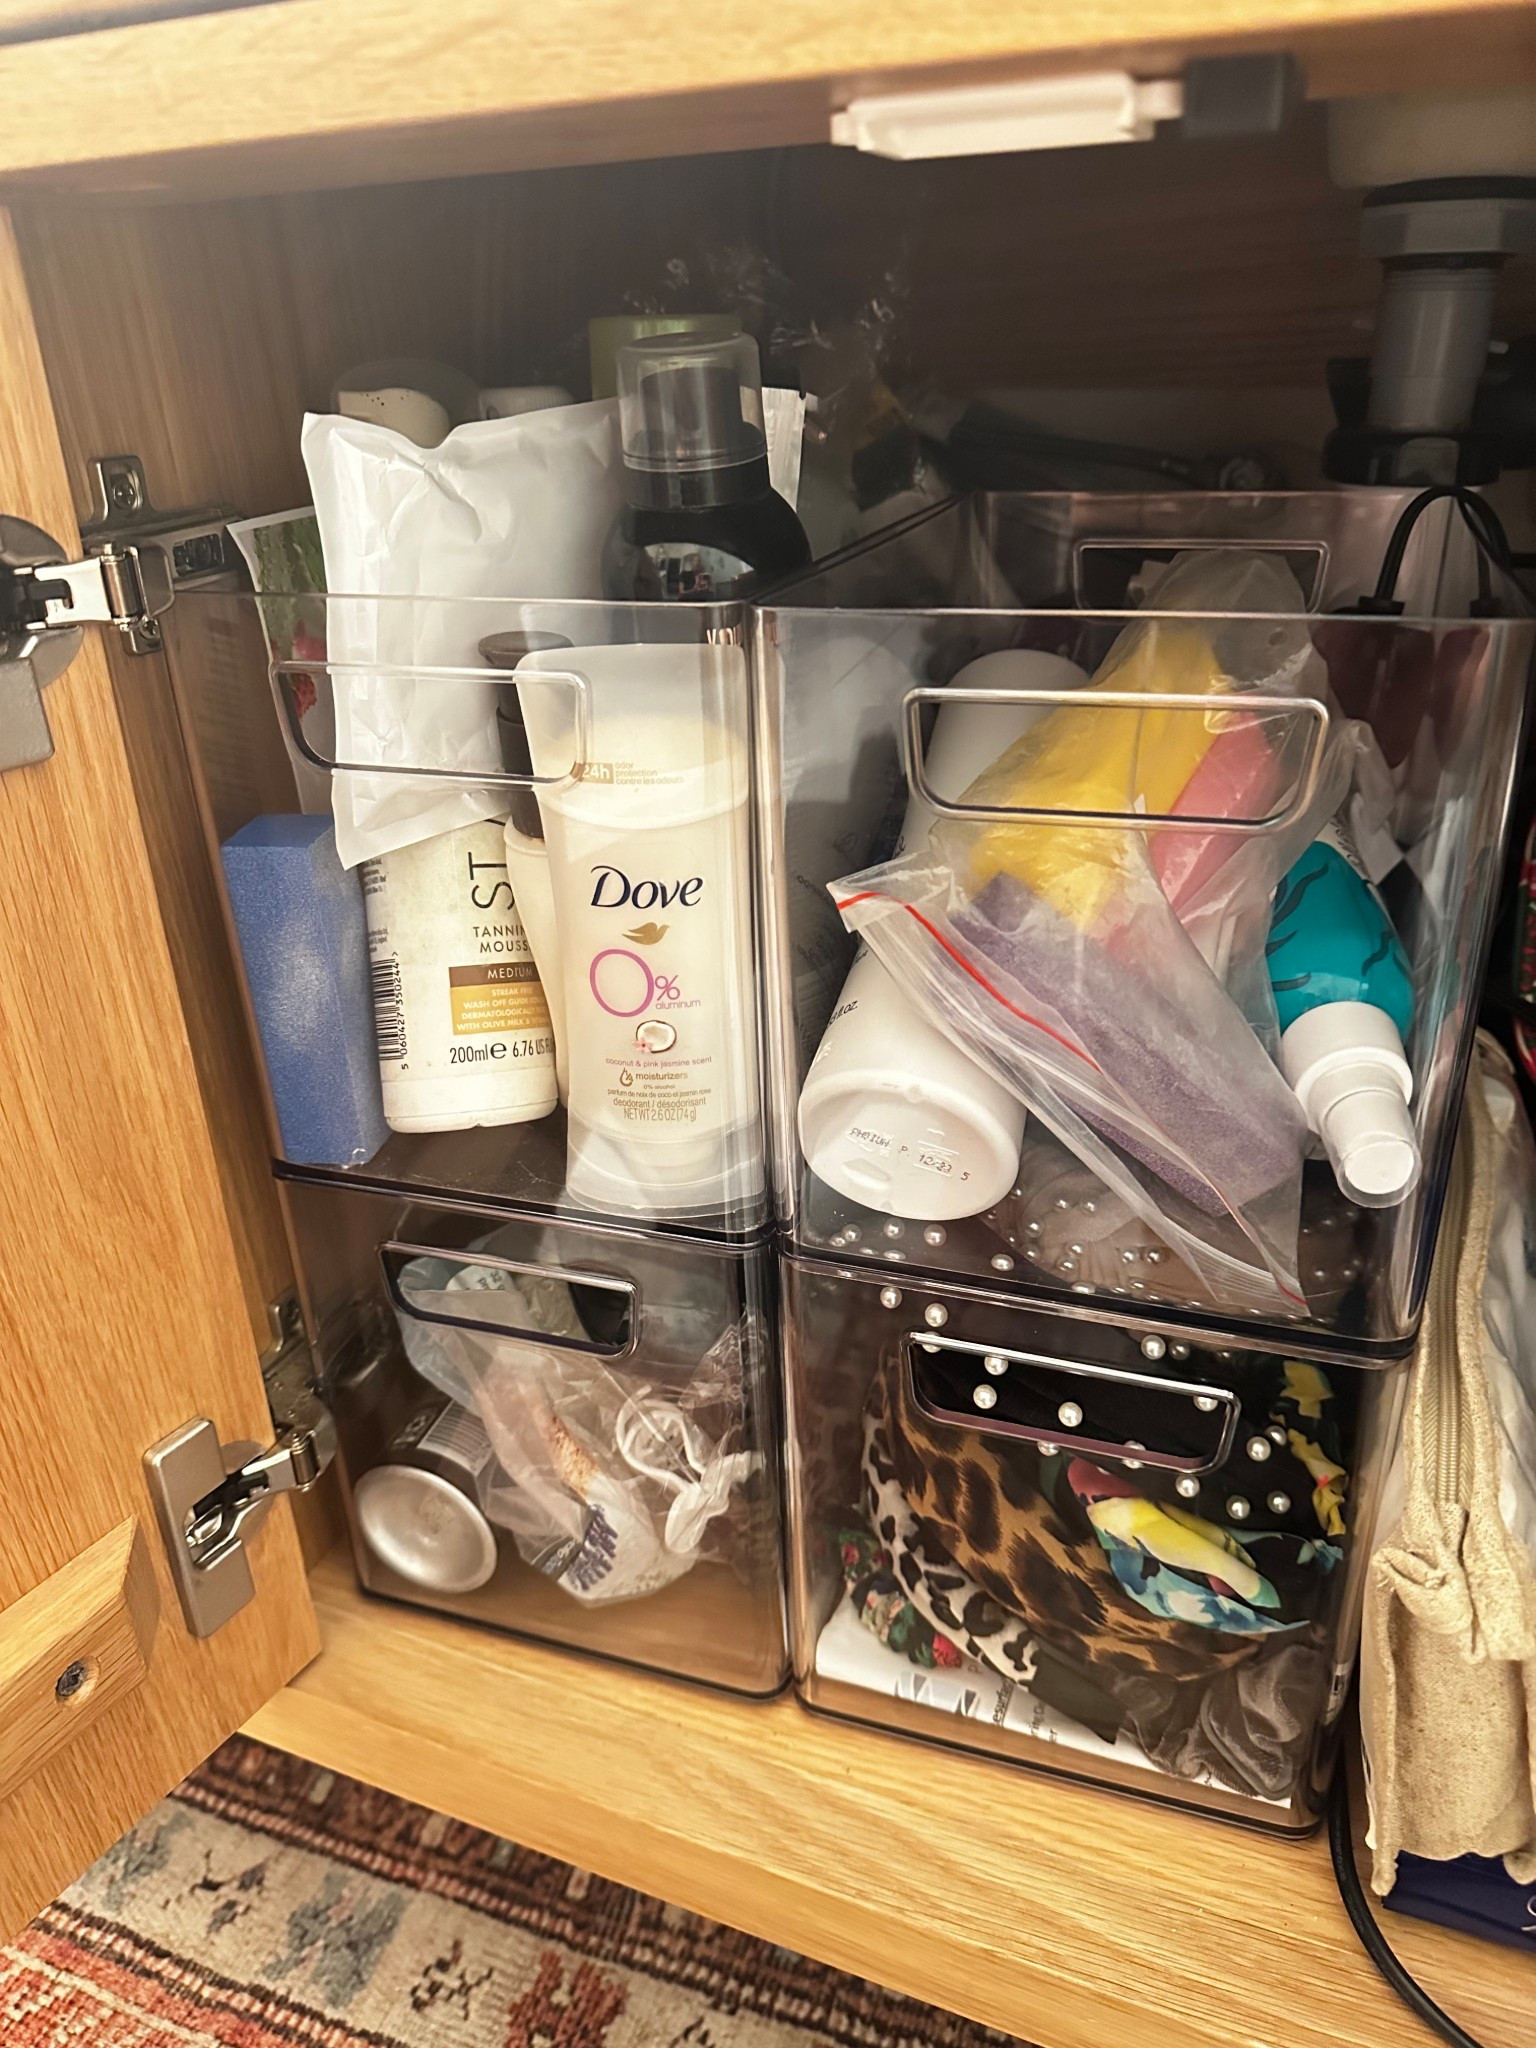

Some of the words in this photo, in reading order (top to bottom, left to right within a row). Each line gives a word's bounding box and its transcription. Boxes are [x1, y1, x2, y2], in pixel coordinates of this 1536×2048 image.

[615, 761, 634, 770] odor
[582, 764, 610, 780] 24h
[615, 769, 658, 778] protection
[616, 777, 642, 785] contre
[643, 777, 655, 785] les
[591, 865, 703, 909] Dove
[473, 924, 526, 938] TANNIN
[480, 940, 530, 953] MOUSS
[487, 967, 533, 979] MEDIUM
[491, 987, 518, 997] STREAK
[463, 999, 489, 1009] WASH
[492, 998, 507, 1007] OFF
[655, 999, 701, 1010] aluminum
[456, 1021, 480, 1031] WITH
[481, 1018, 505, 1028] OLIVE
[507, 1018, 524, 1027] MILK
[512, 1039, 534, 1058] 6.76
[605, 1058, 634, 1067] coconut
[643, 1060, 659, 1068] pink
[660, 1059, 690, 1069] jasmine
[692, 1056, 712, 1065] scent
[635, 1072, 689, 1080] moisturizers
[607, 1088, 627, 1096] parfum
[679, 1089, 698, 1098] jasmin
[613, 1097, 650, 1108] deodorant
[657, 1097, 706, 1109] désodorisant
